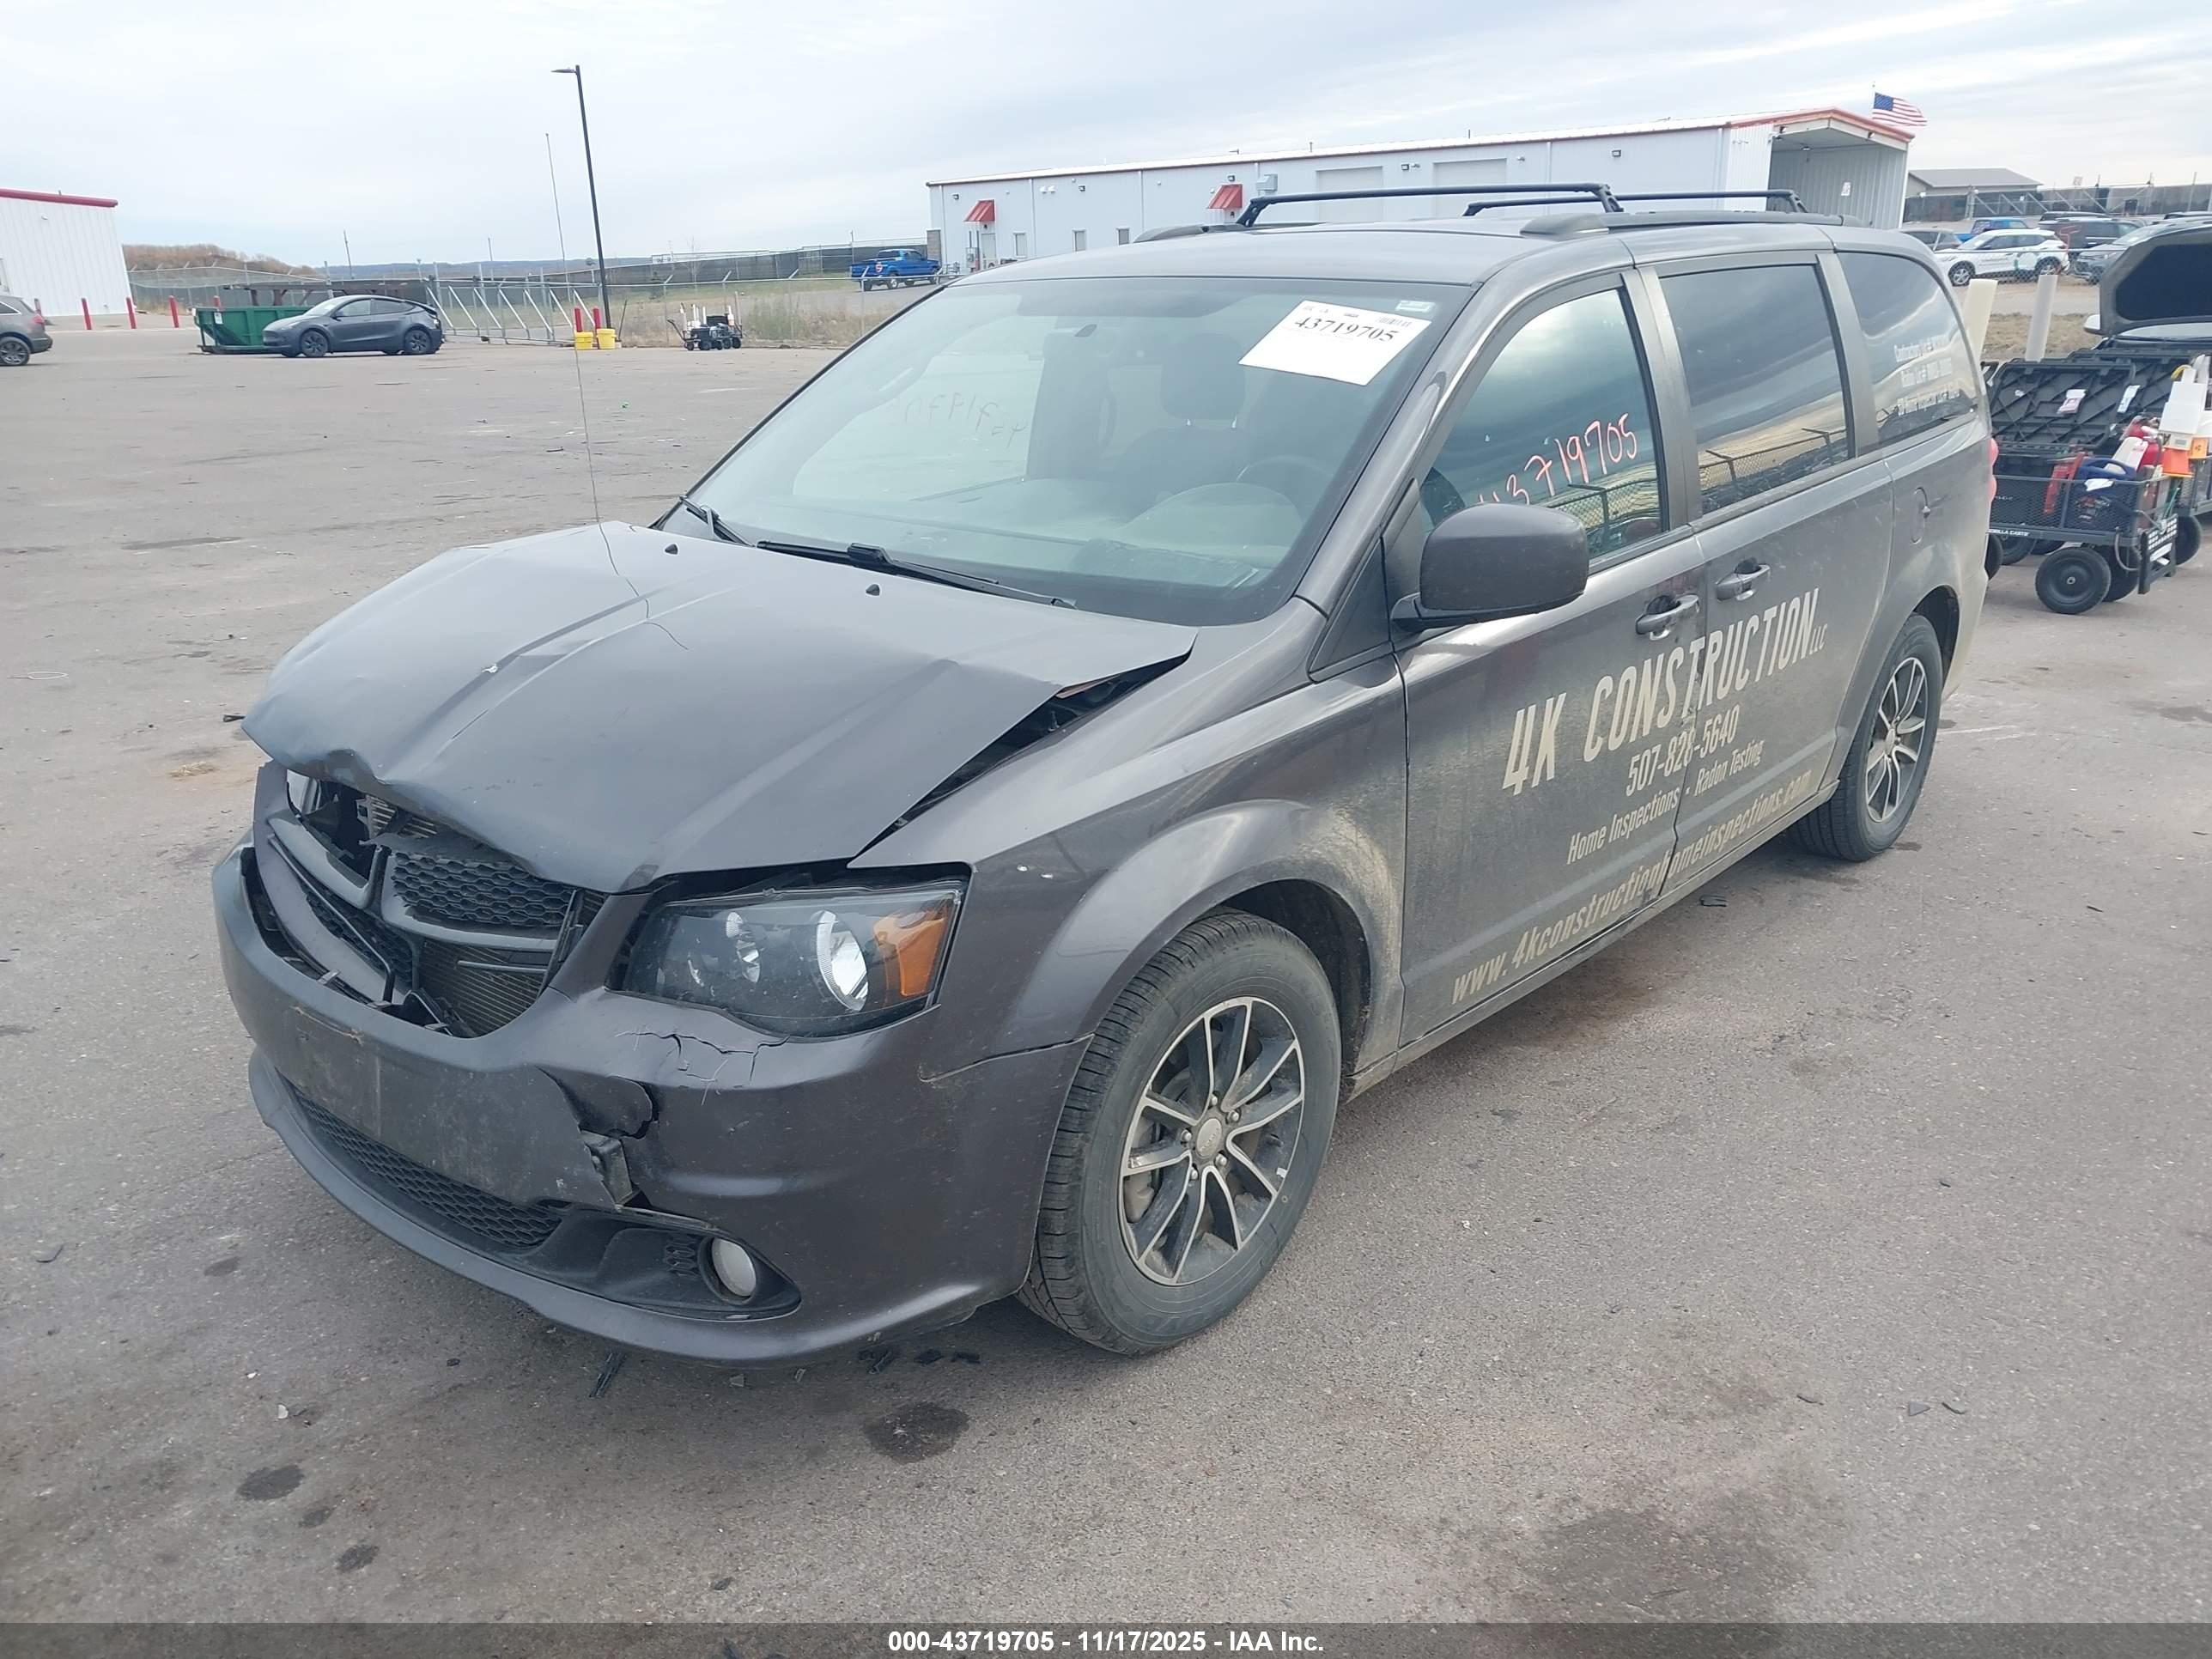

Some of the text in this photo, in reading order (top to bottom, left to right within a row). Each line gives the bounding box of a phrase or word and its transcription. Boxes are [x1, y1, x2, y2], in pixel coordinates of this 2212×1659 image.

[1295, 316, 1400, 342] 43719705
[1477, 412, 1638, 506] 3719705
[1502, 692, 1567, 796] 4K
[1583, 587, 1820, 763] CONSTRUCTION
[1566, 739, 1765, 865] Home Inspections Radon Testing
